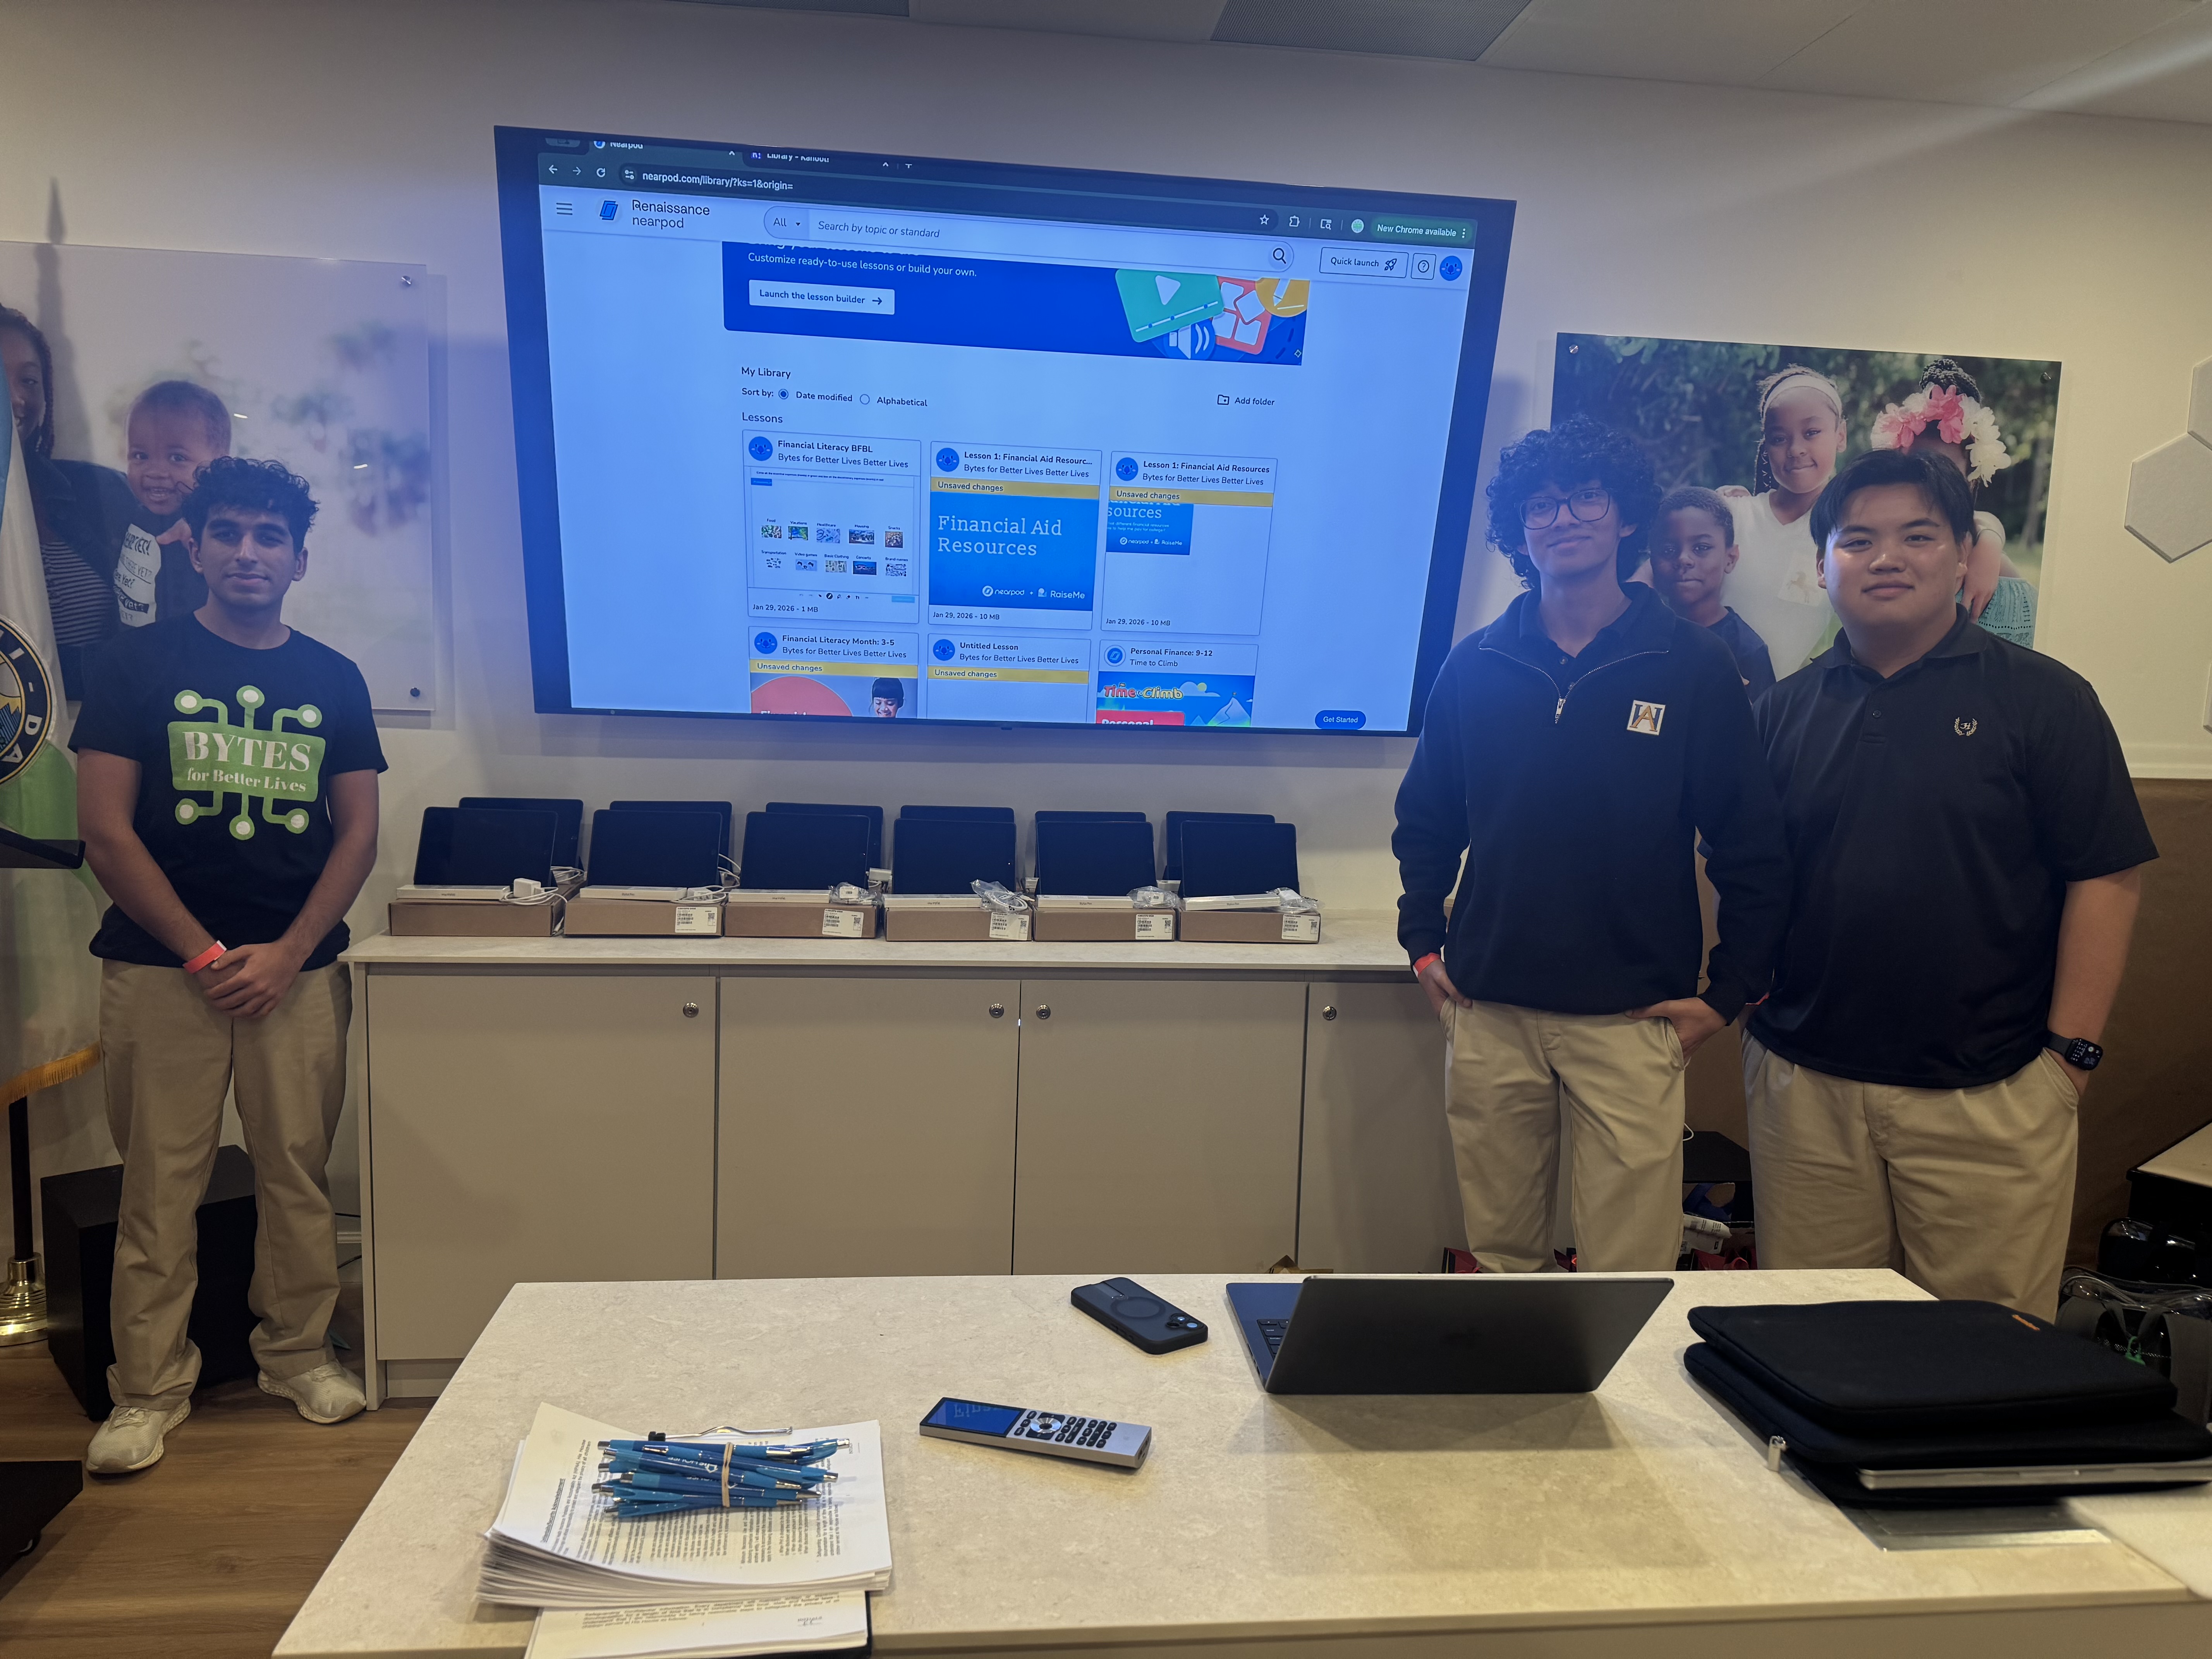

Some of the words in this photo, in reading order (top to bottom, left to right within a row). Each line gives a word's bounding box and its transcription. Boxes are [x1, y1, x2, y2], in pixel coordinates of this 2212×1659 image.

[642, 171, 793, 191] nearpod.com/library/?ks=1&origin=
[632, 199, 710, 216] Renaissance
[632, 216, 684, 229] nearpod
[773, 218, 787, 227] All
[818, 221, 849, 232] Search
[852, 223, 862, 234] by
[865, 225, 887, 235] topic
[900, 227, 940, 238] standard
[1377, 224, 1394, 233] New
[1395, 225, 1423, 235] Chrome
[1425, 227, 1456, 237] available
[748, 252, 796, 264] Customize
[799, 256, 857, 268] ready-to-use
[860, 260, 894, 271] lessons
[908, 263, 930, 273] build
[933, 267, 953, 276] your
[955, 268, 977, 276] own.
[1331, 257, 1352, 266] Quick
[1354, 259, 1379, 267] launch
[759, 289, 789, 299] Launch
[807, 293, 833, 302] lesson
[836, 294, 865, 304] builder
[742, 367, 755, 377] My
[758, 368, 791, 379] Library
[762, 389, 774, 398] by:
[796, 391, 815, 400] Date
[817, 393, 852, 402] modified
[877, 396, 928, 407] Alphabetical
[1235, 397, 1250, 405] Add
[1252, 397, 1275, 406] folder
[742, 412, 783, 423] Lessons
[778, 440, 815, 450] Financial
[817, 442, 849, 453] Literacy
[778, 453, 800, 463] Bytes
[816, 455, 840, 464] Better
[864, 459, 887, 467] Better
[964, 452, 991, 460] Lesson
[1003, 453, 1038, 462] Financial
[1056, 457, 1092, 465] Resourc...
[964, 464, 985, 473] Bytes
[1181, 462, 1214, 471] Financial
[1232, 465, 1269, 473] Resources
[1142, 473, 1163, 482] Bytes
[938, 481, 970, 490] Unsaved
[972, 484, 1003, 492] changes
[1116, 490, 1148, 498] Unsaved
[1150, 491, 1180, 500] changes
[938, 515, 1027, 534] Financial
[1031, 520, 1062, 536] Aid
[938, 538, 1037, 556] Resources
[1050, 590, 1085, 599] RaiseMe
[819, 636, 850, 646] Literacy
[960, 642, 991, 650] Untitled
[960, 654, 980, 662] Bytes
[792, 663, 823, 672] changes
[968, 670, 997, 678] changes
[1104, 685, 1136, 697] Time
[1142, 687, 1183, 699] Climb
[1336, 716, 1358, 724] Started
[182, 731, 311, 772] BYTES
[187, 767, 210, 782] for
[213, 769, 261, 787] Better
[264, 776, 306, 792] Lives
